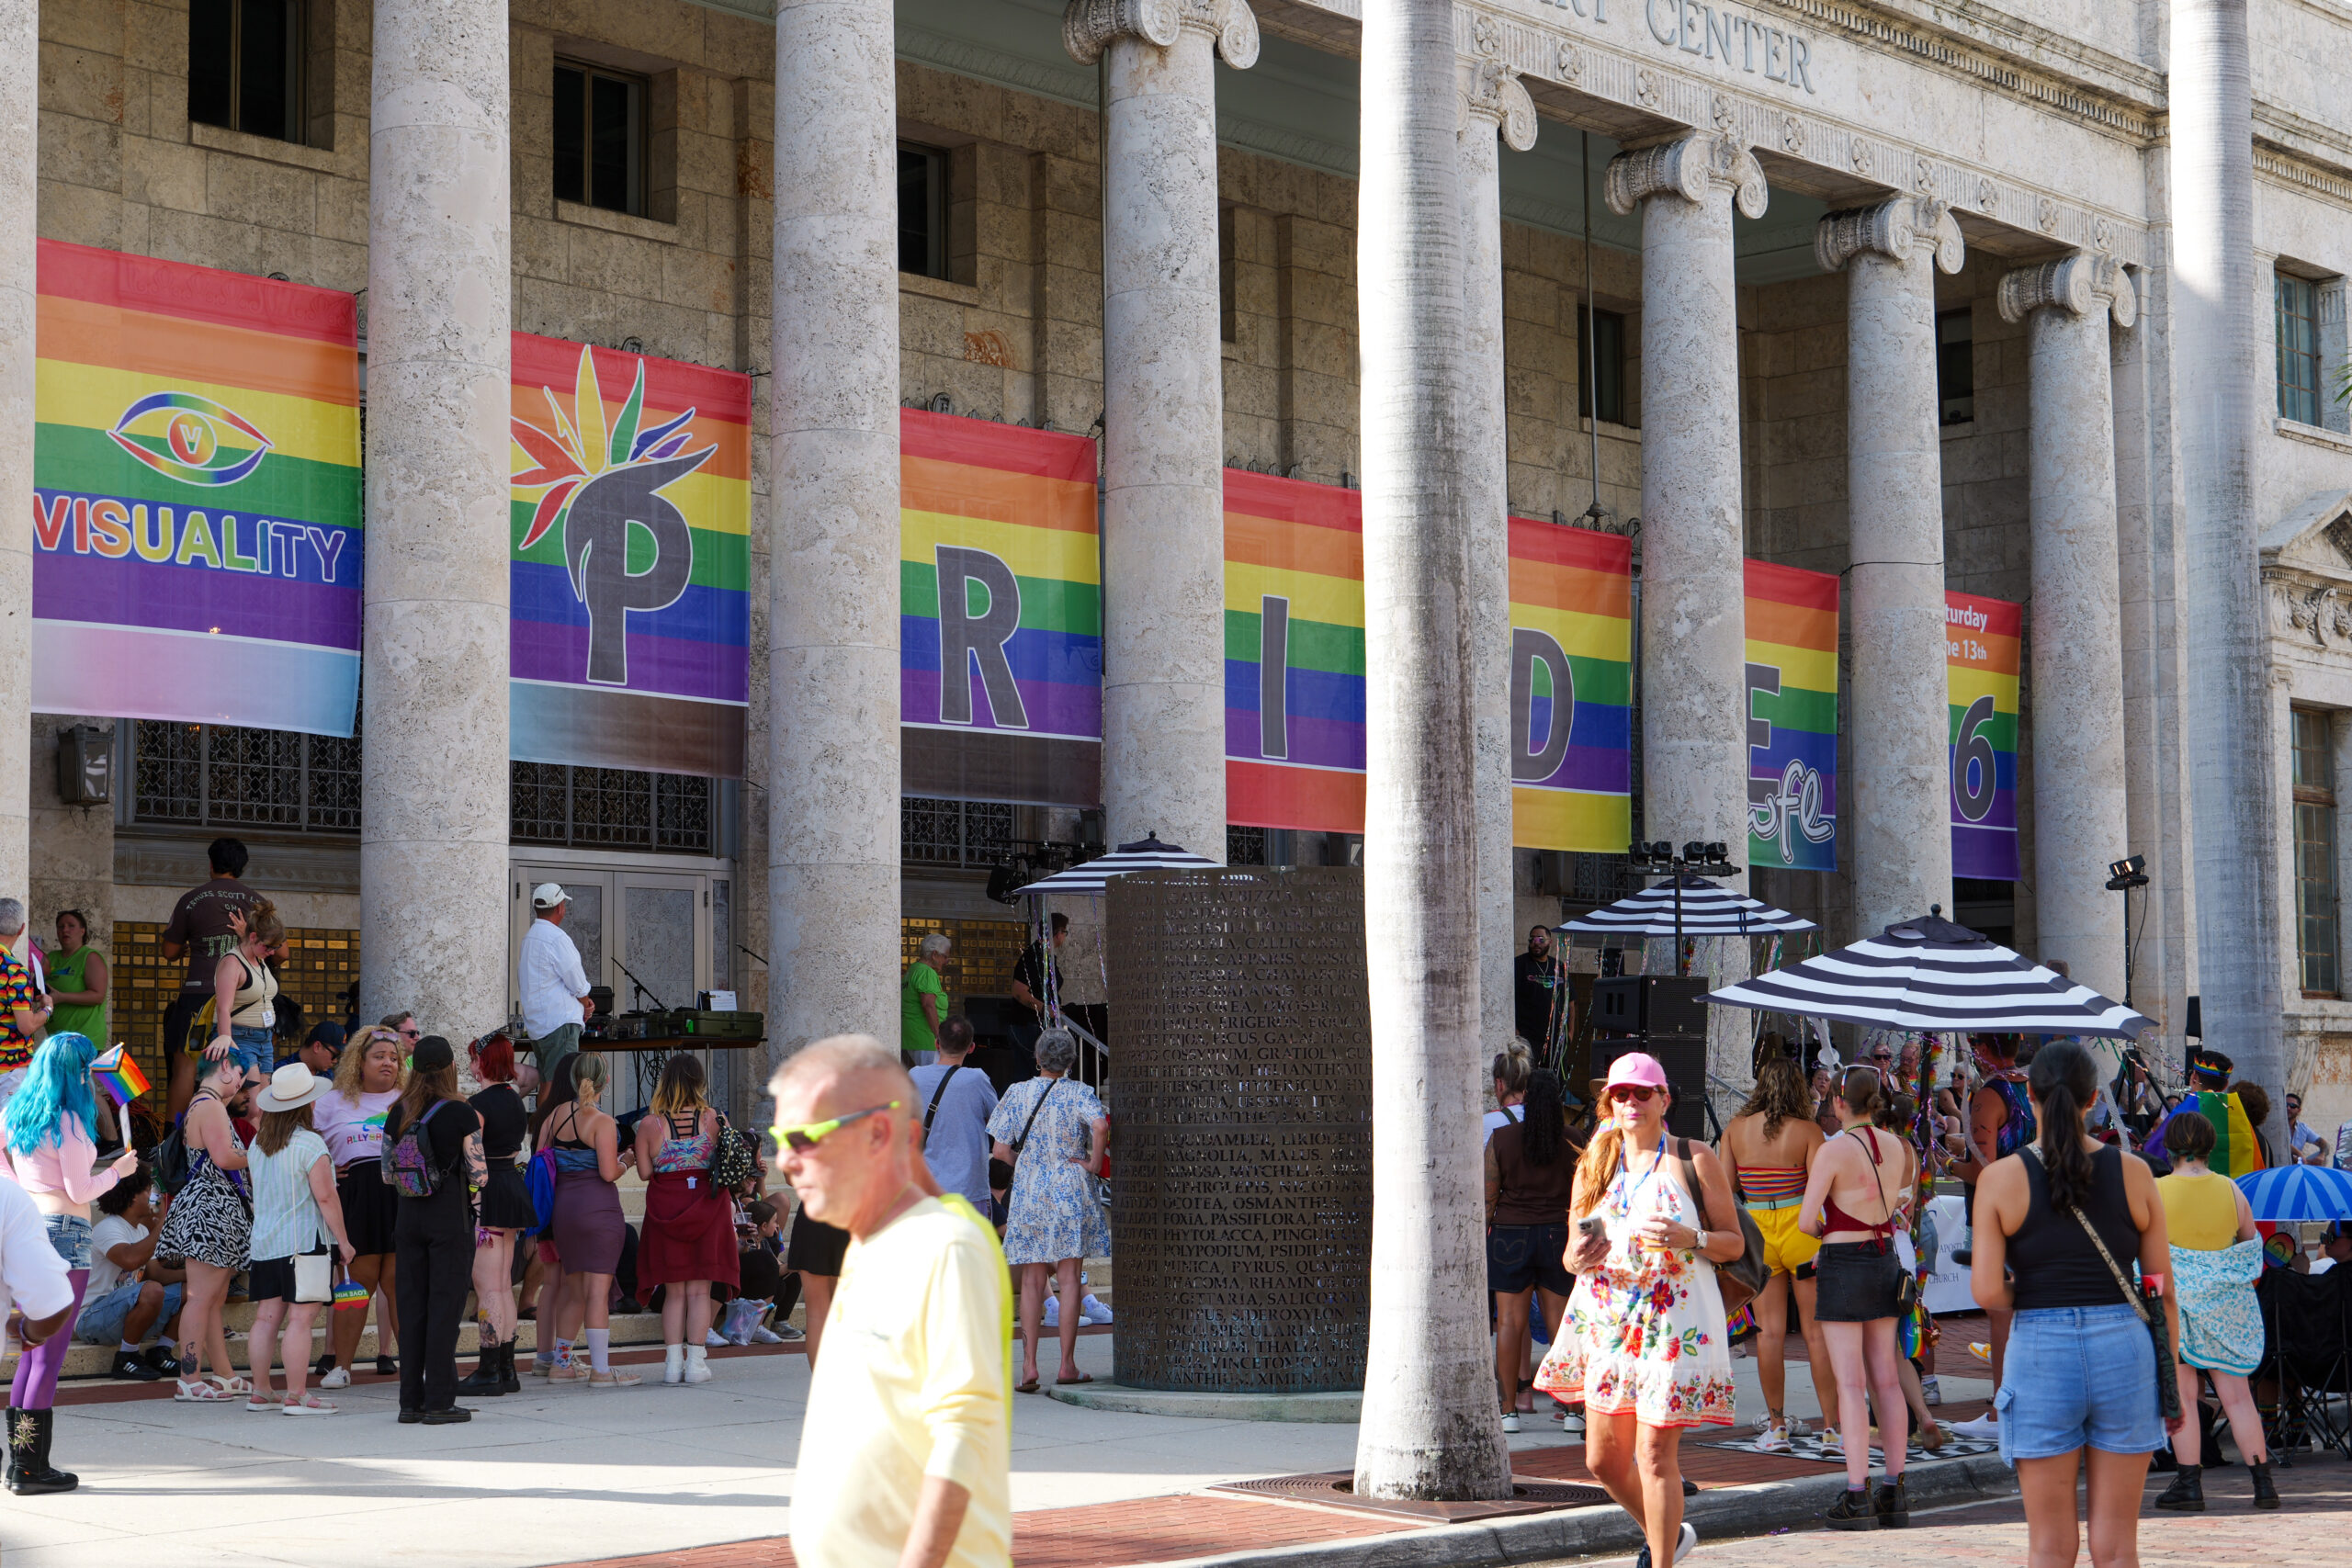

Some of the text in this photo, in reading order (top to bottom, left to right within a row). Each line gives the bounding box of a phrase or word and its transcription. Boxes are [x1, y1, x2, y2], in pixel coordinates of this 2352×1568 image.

[1646, 0, 1815, 95] CENTER
[33, 492, 346, 583] VISUALITY
[1945, 604, 1988, 634] turday
[1946, 638, 1986, 660] ne 13th
[1950, 694, 1997, 822] 6
[1747, 758, 1835, 864] wfl
[217, 890, 246, 900] SCOTT
[1250, 1064, 1372, 1076] HELIANTHEMU
[1939, 1243, 1963, 1254] APOSTL
[1928, 1273, 1959, 1284] CHURCH
